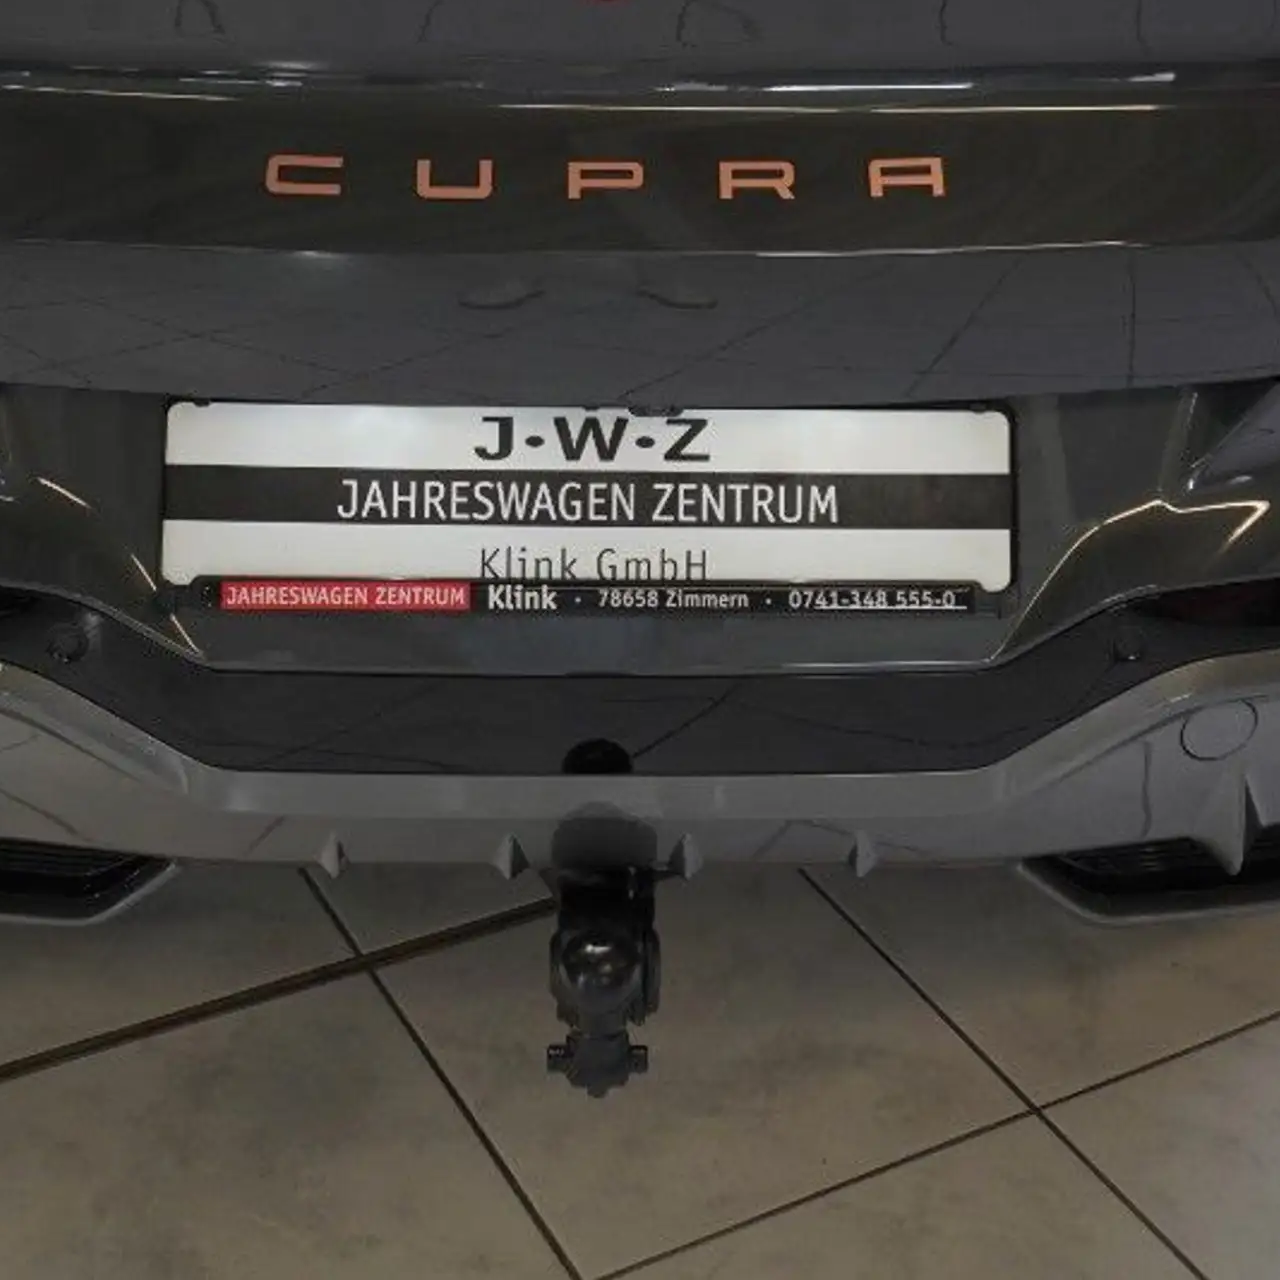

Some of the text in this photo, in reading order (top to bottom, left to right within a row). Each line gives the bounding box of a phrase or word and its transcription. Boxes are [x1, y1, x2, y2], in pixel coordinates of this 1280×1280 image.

[266, 154, 947, 200] CUPRA
[474, 416, 711, 462] J·W·Z
[336, 478, 839, 523] JAHRESWAGEN ZENTRUM
[480, 546, 708, 581] Klink GmbH
[226, 585, 956, 610] JAHRESWAGEN ZENTRUM Klink 78658 Zimmern 0741-348 555-0
